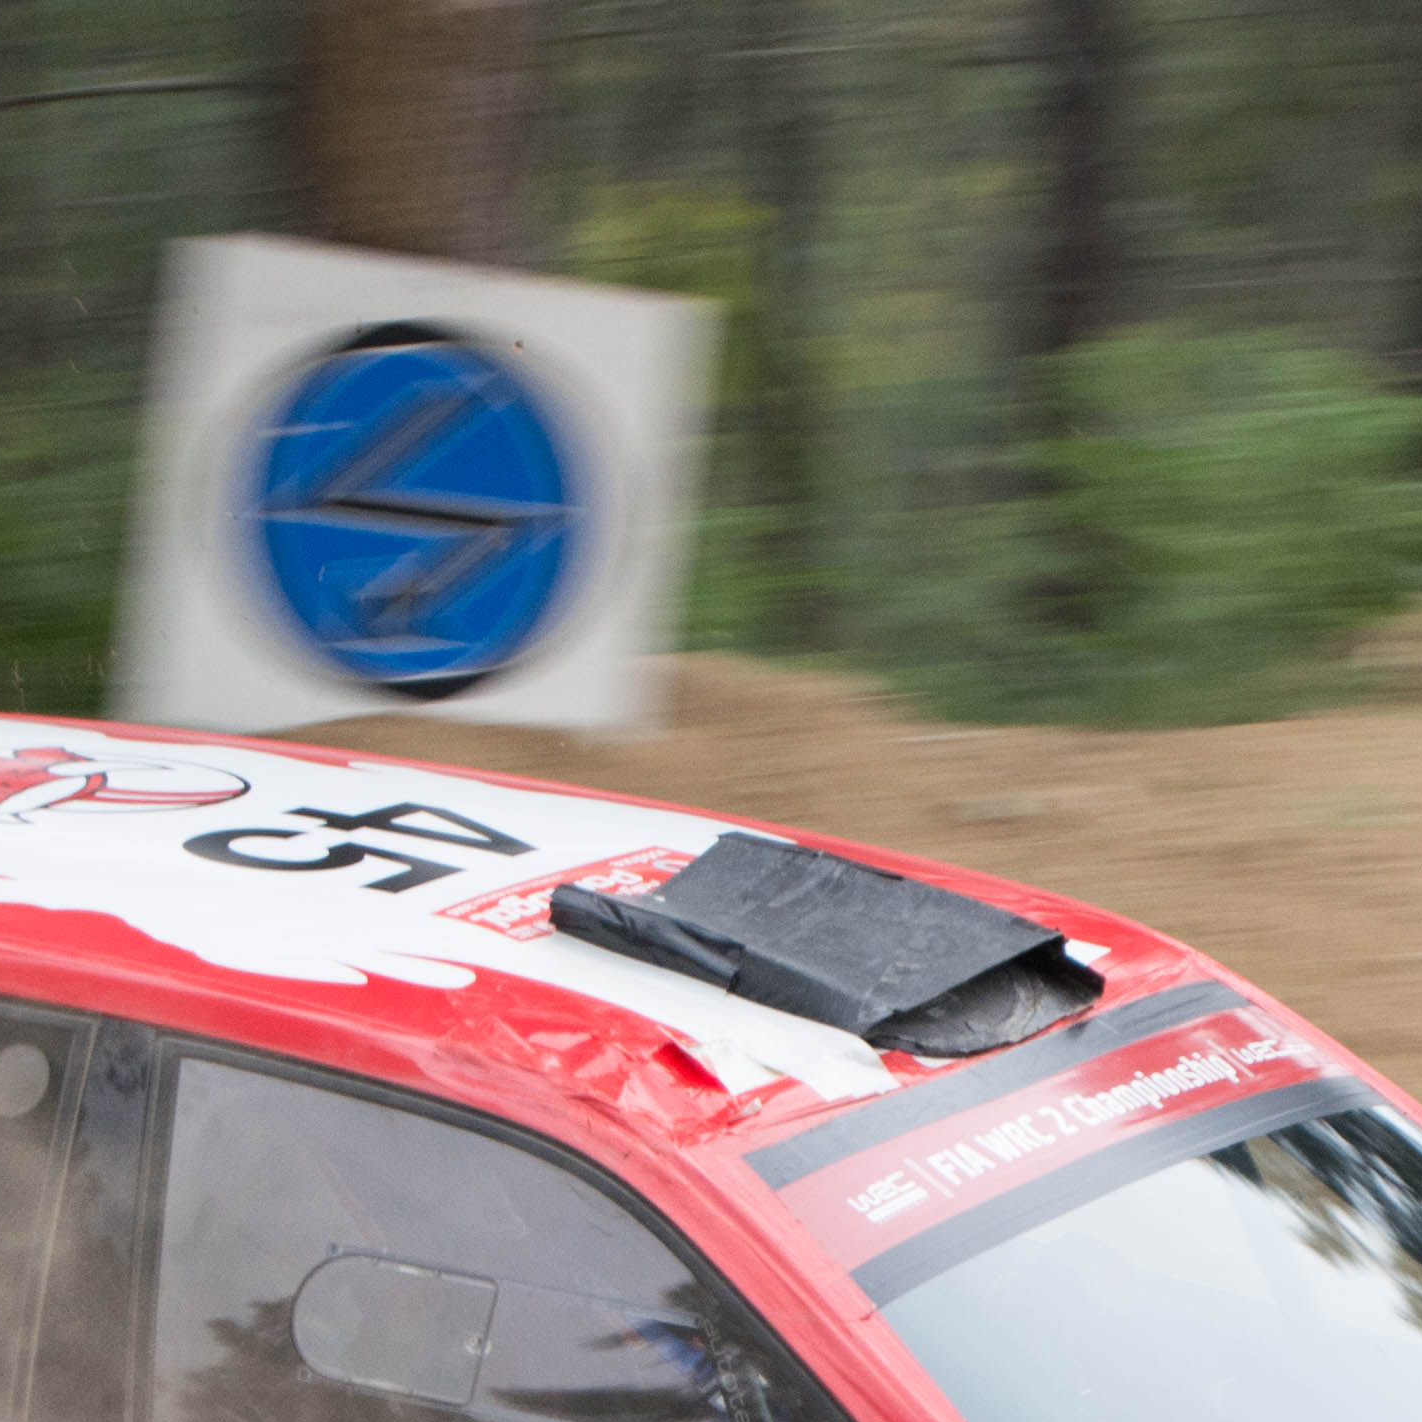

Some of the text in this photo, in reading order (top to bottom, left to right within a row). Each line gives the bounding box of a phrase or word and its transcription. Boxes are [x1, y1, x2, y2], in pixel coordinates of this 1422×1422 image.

[182, 802, 538, 893] 45
[926, 1143, 996, 1186] FIA
[980, 1113, 1056, 1163] WRC
[1039, 1106, 1079, 1137] 2
[1061, 1049, 1241, 1128] Championship
